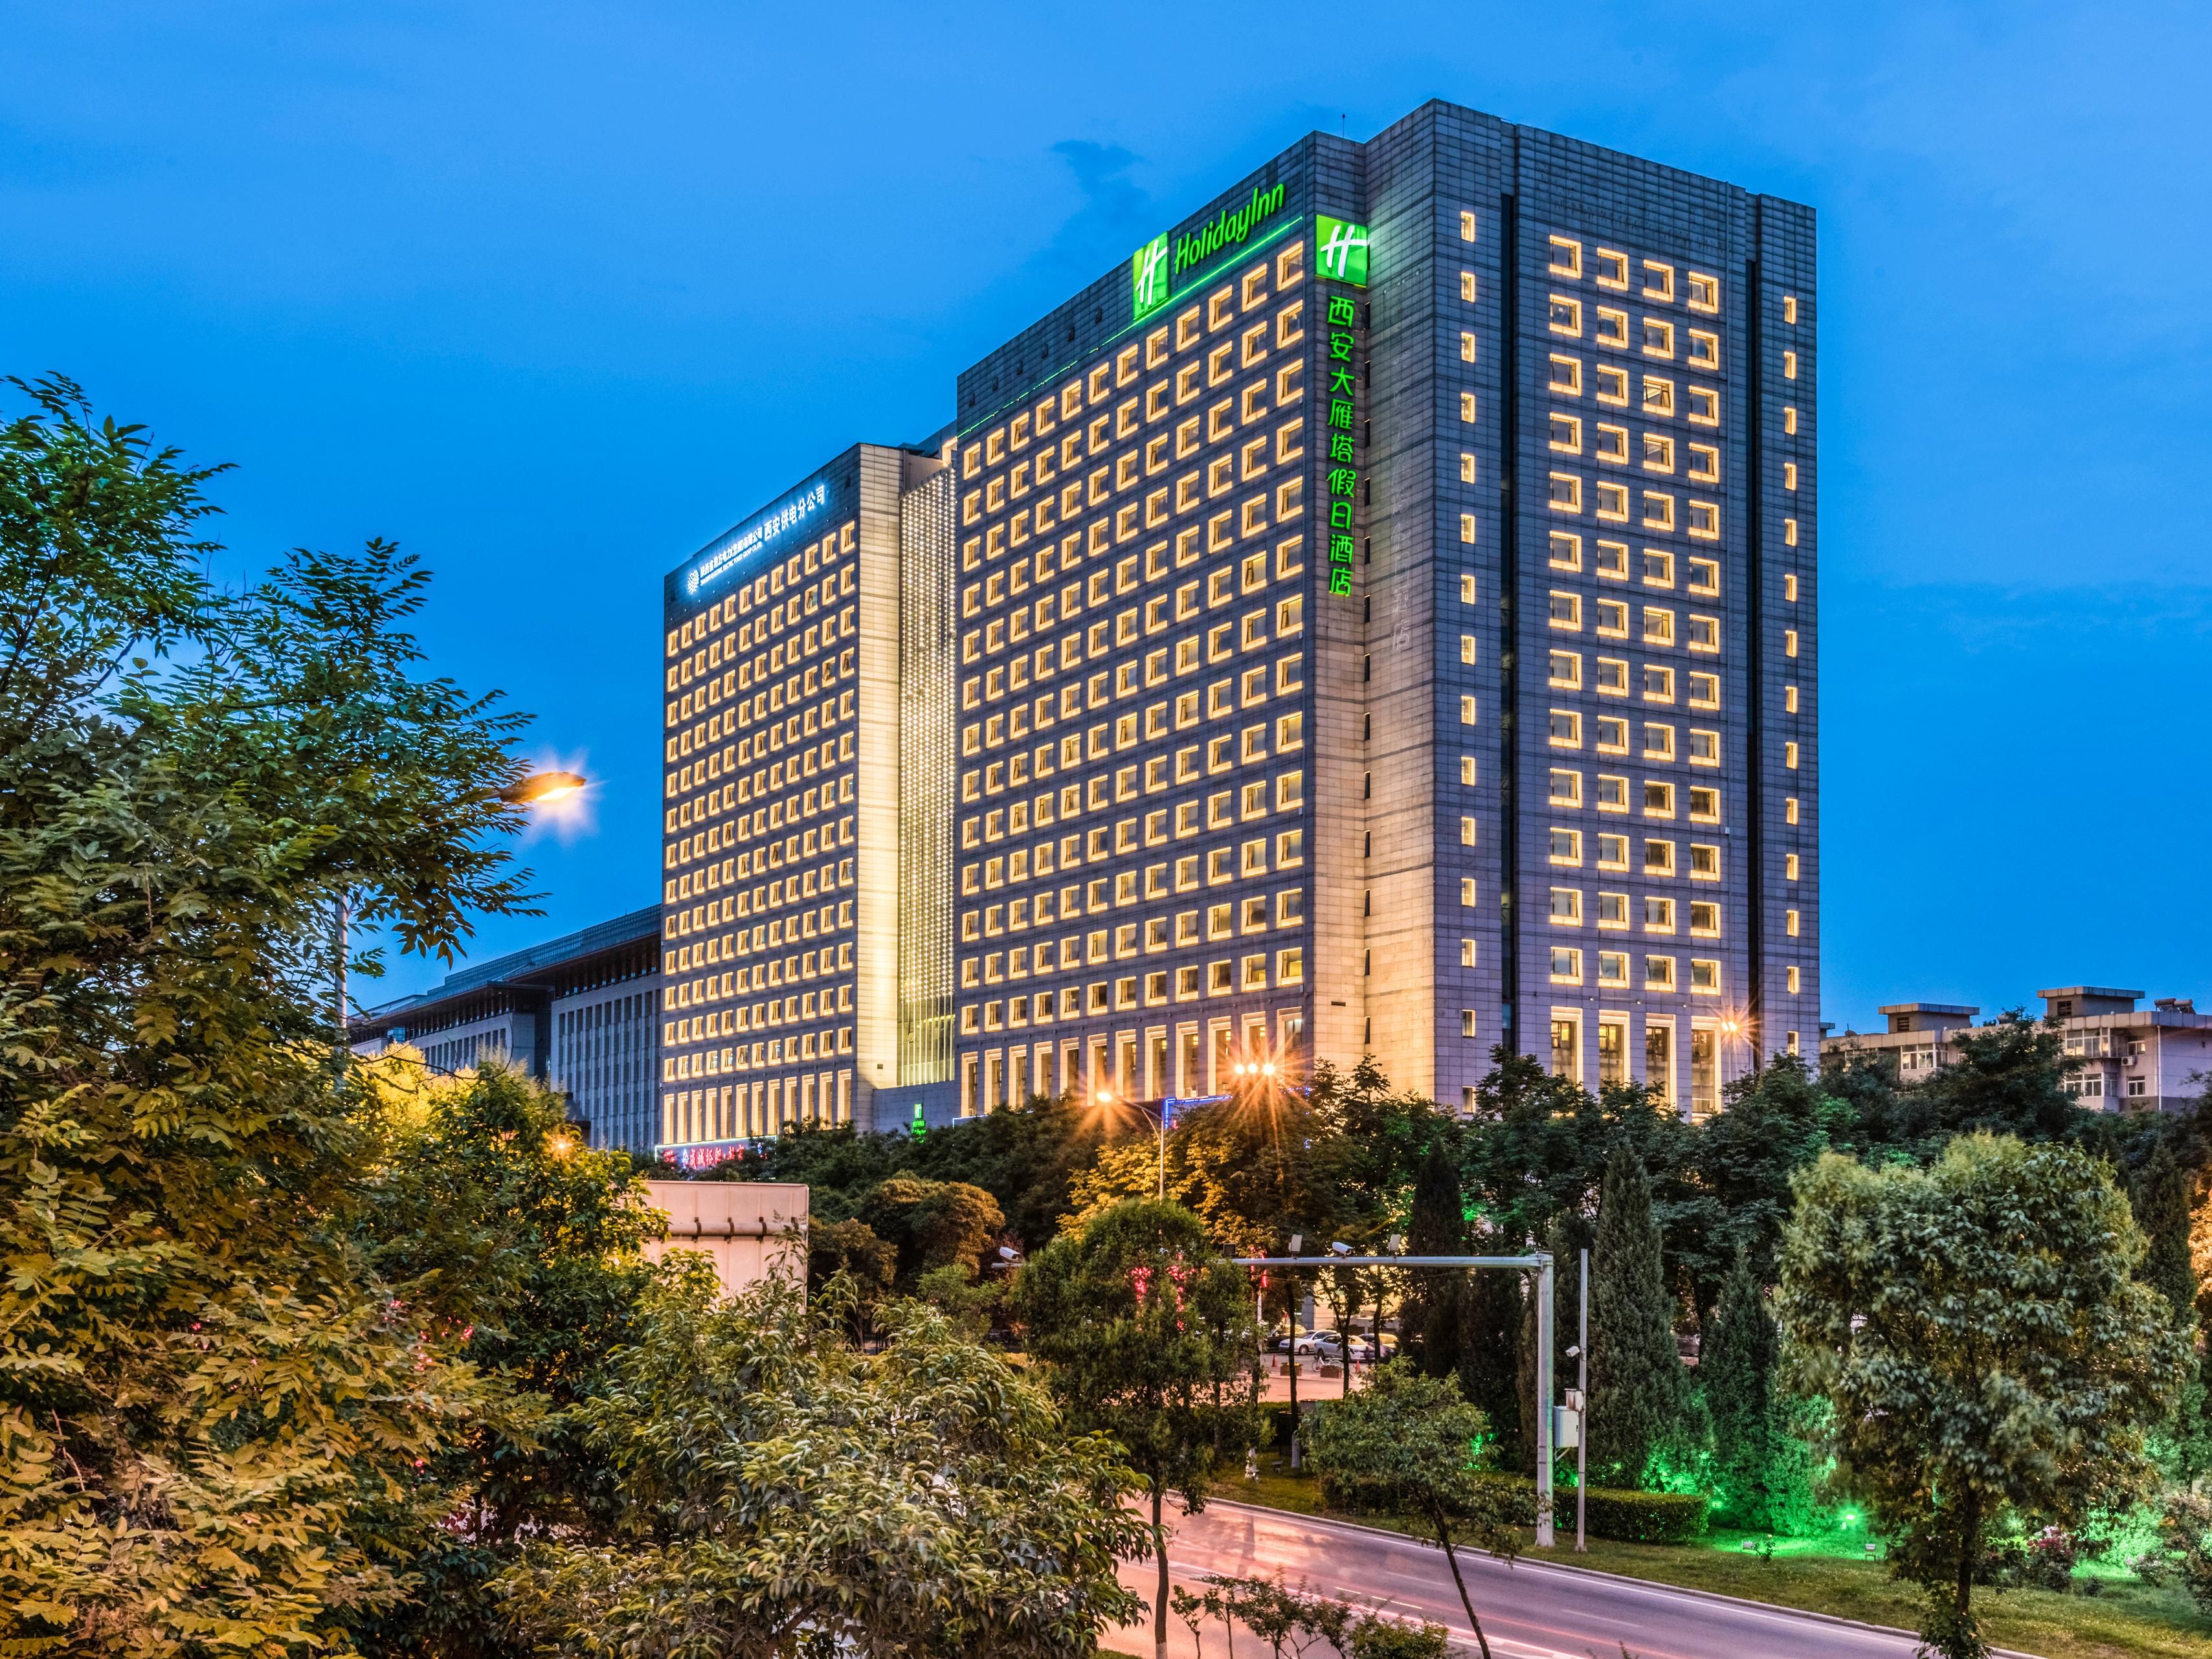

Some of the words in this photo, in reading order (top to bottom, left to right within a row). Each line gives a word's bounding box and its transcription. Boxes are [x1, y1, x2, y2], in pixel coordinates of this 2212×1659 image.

[764, 484, 825, 542] 西安供电分公司
[1326, 295, 1357, 596] 西安大雁塔假日酒店
